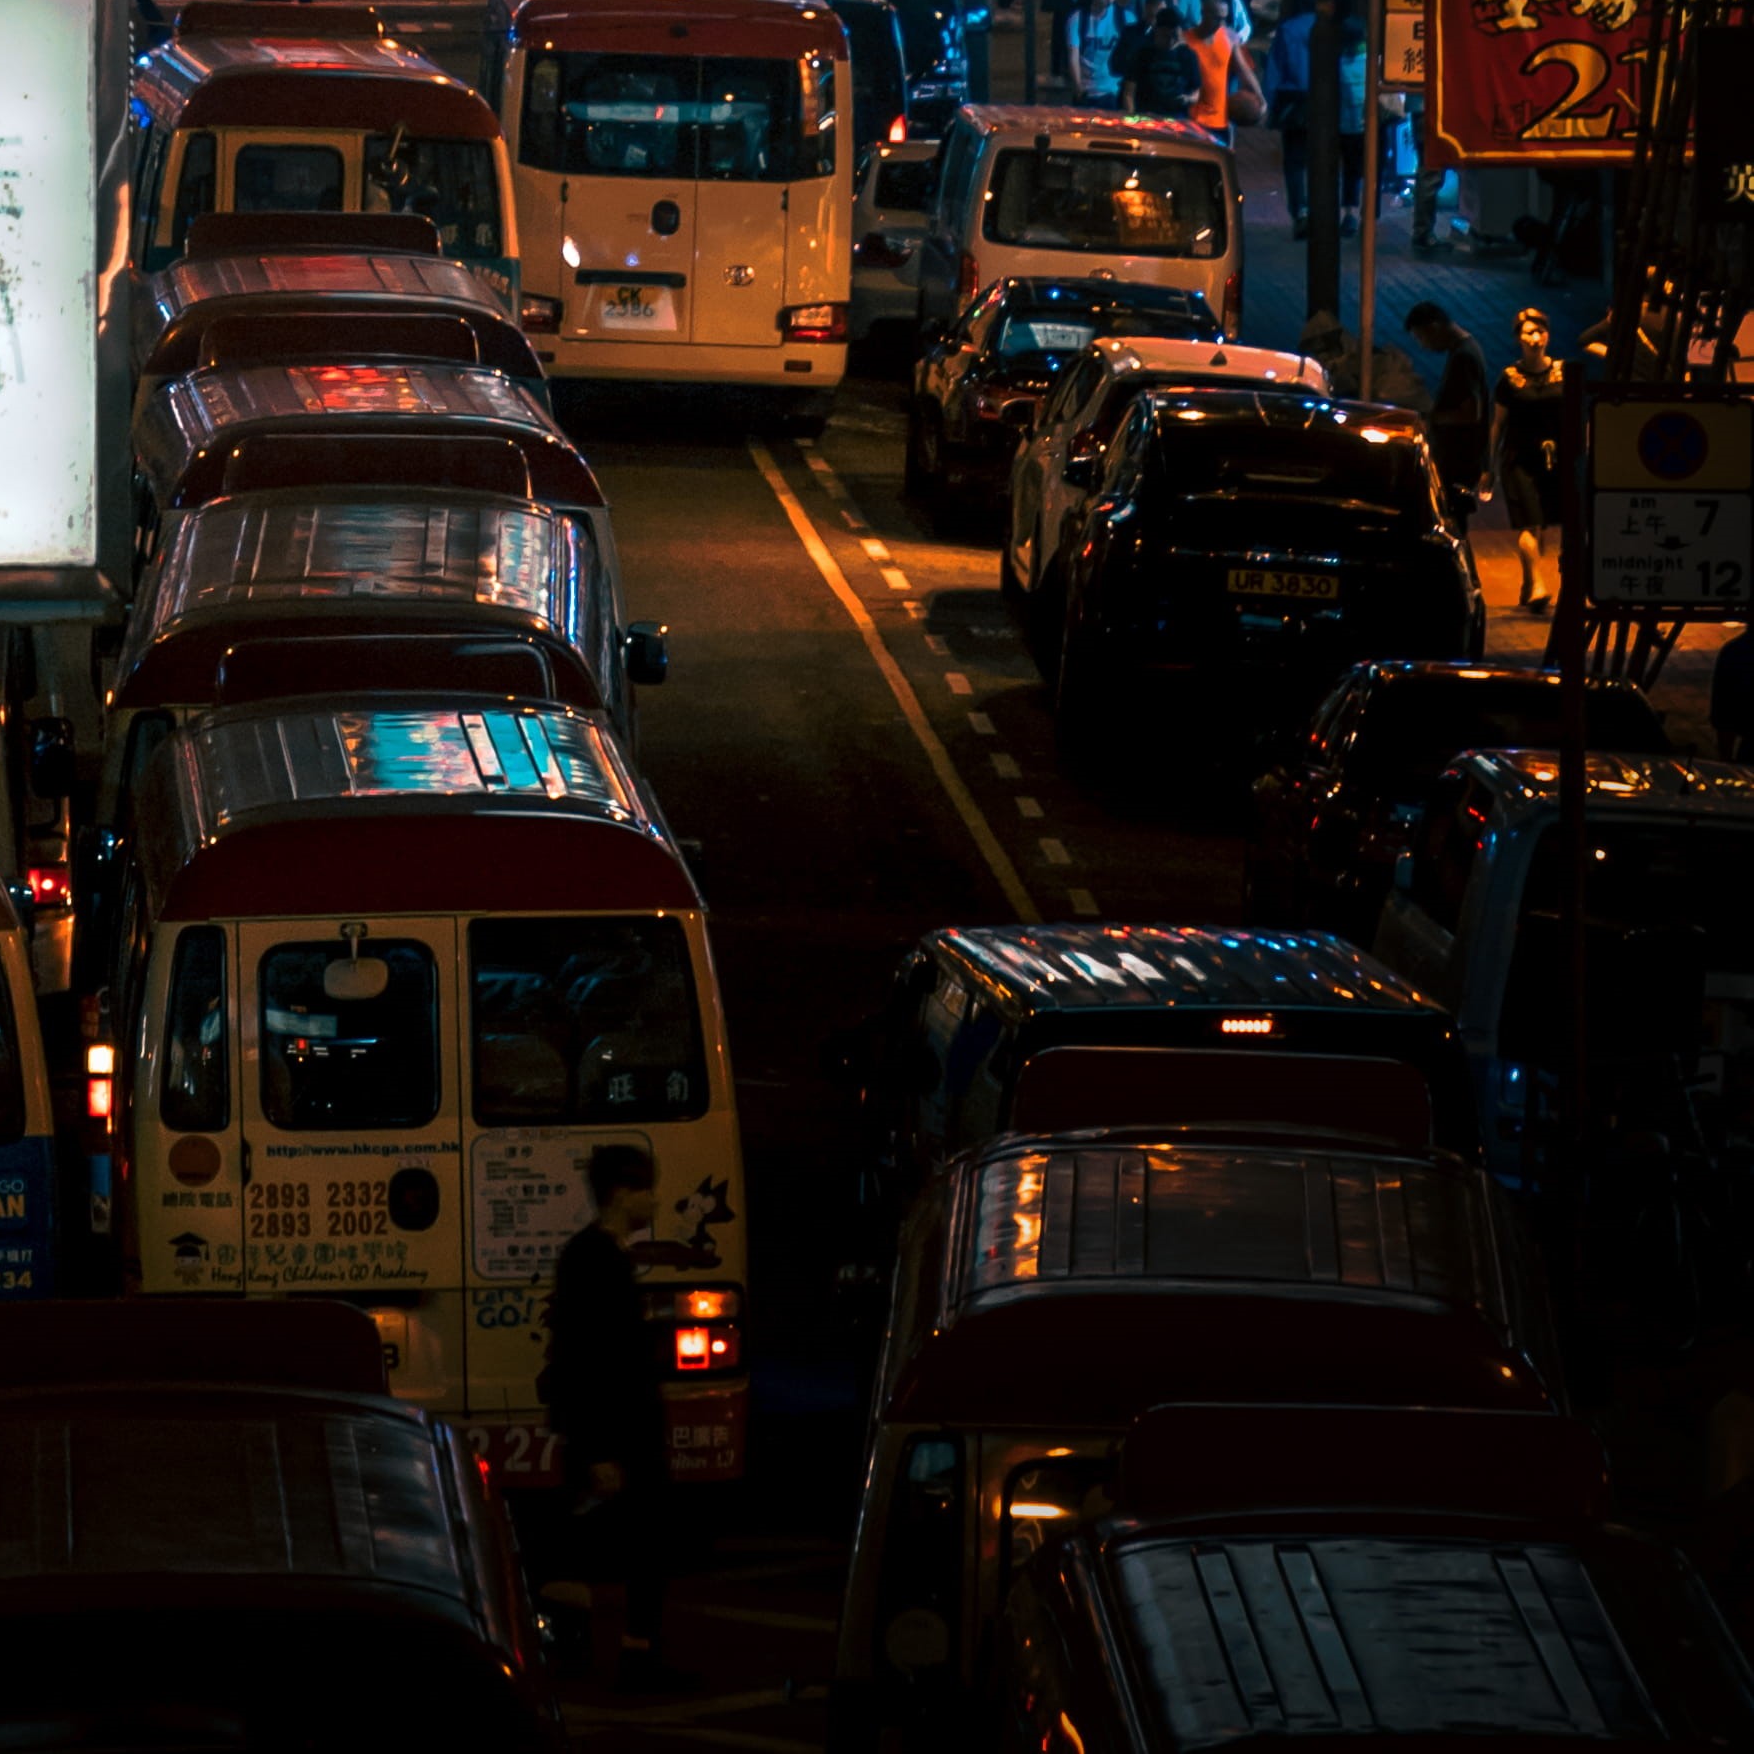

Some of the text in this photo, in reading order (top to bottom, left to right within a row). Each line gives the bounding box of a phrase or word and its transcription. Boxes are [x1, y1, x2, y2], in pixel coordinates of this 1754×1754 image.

[1630, 497, 1657, 508] am
[1621, 515, 1665, 535] 上午
[1695, 500, 1719, 535] 7
[1602, 556, 1684, 572] midnight
[1620, 576, 1664, 596] 午夜
[1697, 562, 1742, 596] 12
[250, 1182, 388, 1209] 2893 2332
[250, 1211, 388, 1238] 2893 2002
[211, 1267, 242, 1286] Hong
[247, 1267, 279, 1288] Kong
[282, 1264, 346, 1283] Children's
[373, 1265, 429, 1285] Academy
